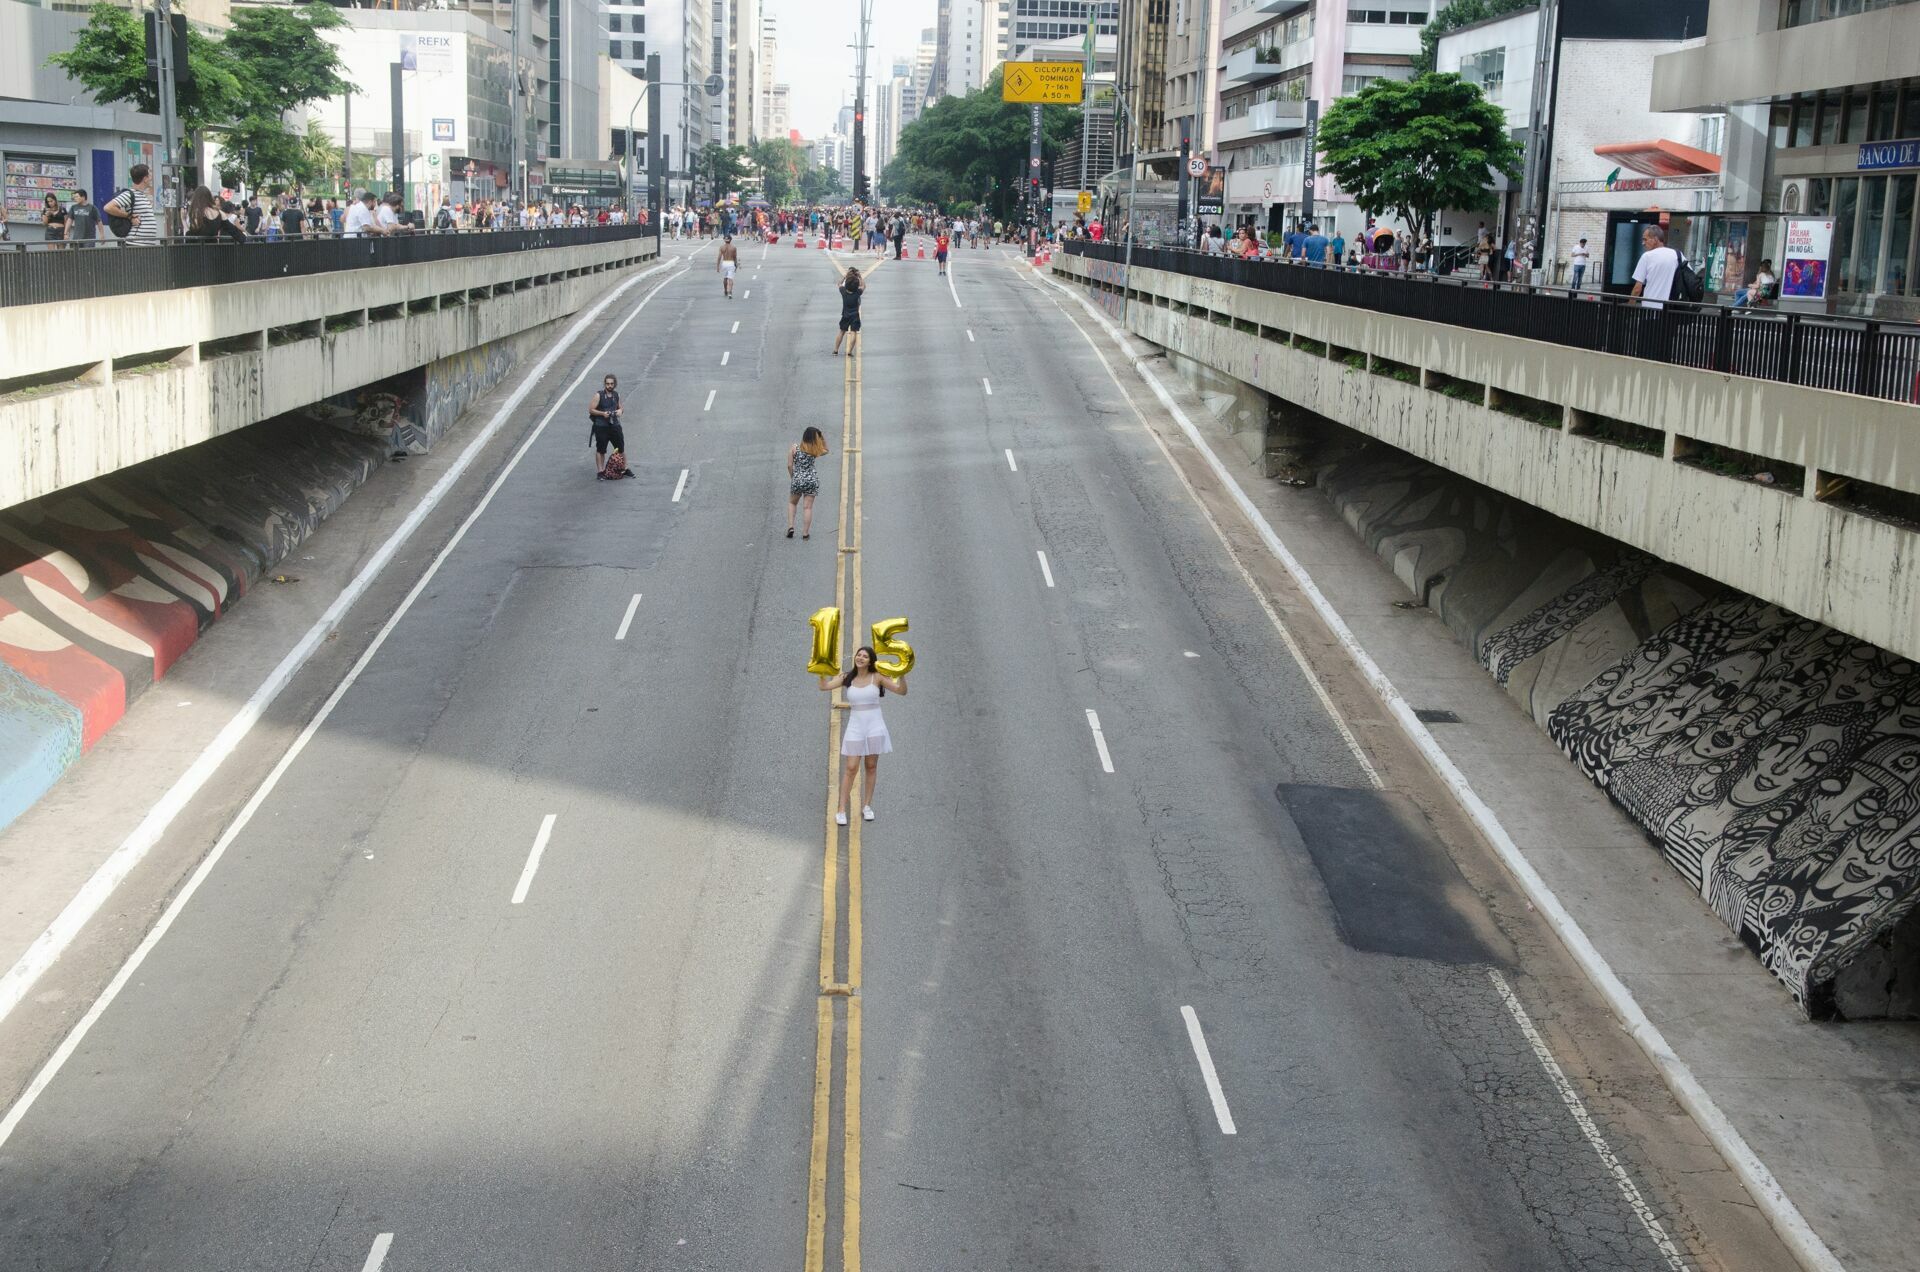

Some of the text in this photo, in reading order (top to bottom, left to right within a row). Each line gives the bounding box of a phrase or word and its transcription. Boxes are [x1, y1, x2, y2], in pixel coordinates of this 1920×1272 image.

[418, 36, 450, 47] REFIX
[1858, 145, 1896, 165] BANCO
[1899, 144, 1914, 163] DE
[1191, 160, 1204, 170] 50
[1199, 205, 1217, 214] 27°C
[1789, 229, 1810, 237] BRILHAR
[1787, 245, 1796, 253] VAI
[1796, 245, 1803, 253] NO
